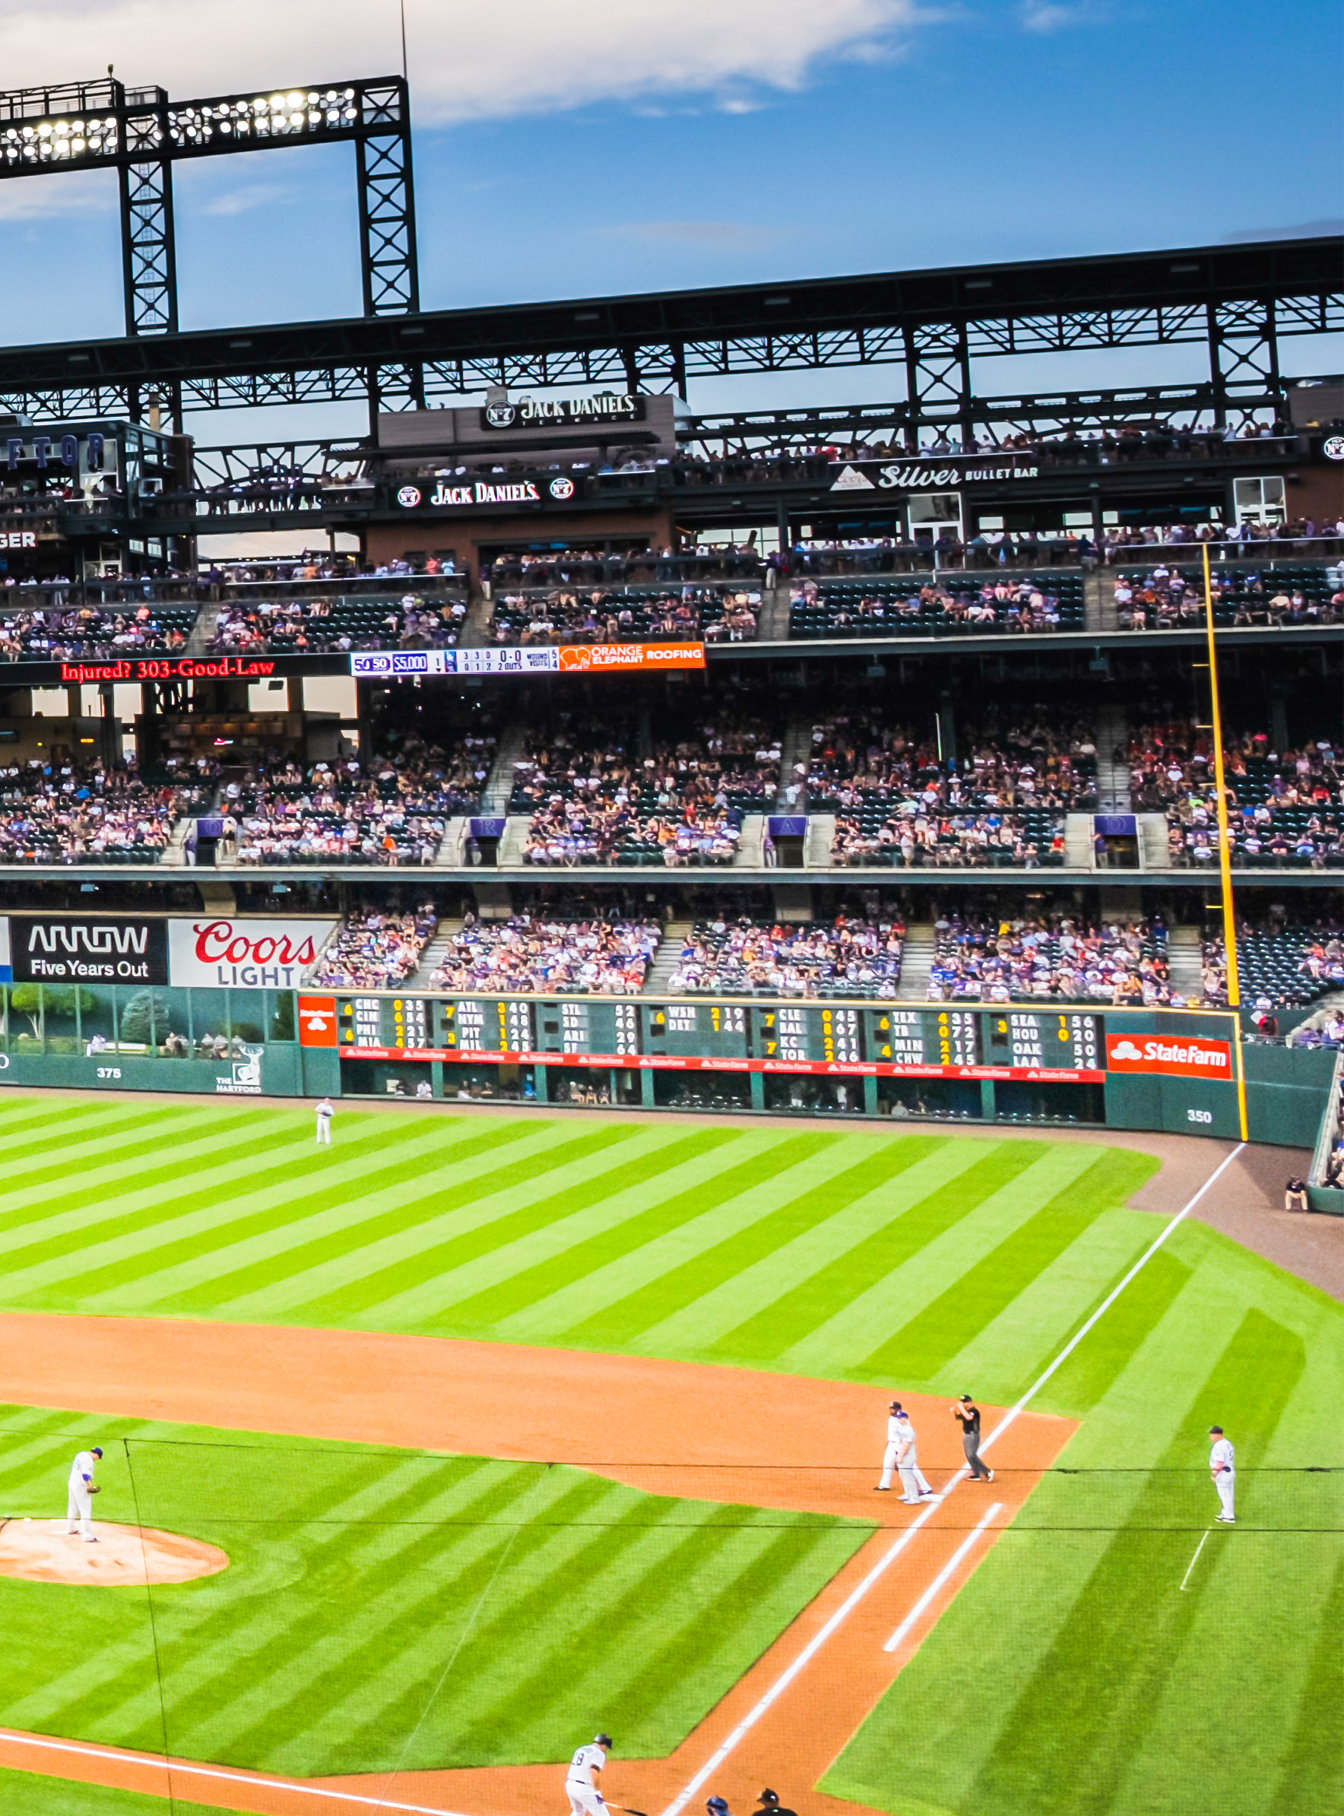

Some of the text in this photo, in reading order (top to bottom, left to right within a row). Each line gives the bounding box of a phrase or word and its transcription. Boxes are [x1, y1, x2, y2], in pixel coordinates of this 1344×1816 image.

[520, 396, 566, 419] JACK
[877, 463, 1039, 490] Silver BULLET BAR
[430, 484, 474, 506] JACK
[591, 646, 643, 657] ORANGE
[646, 649, 702, 660] ROOFING
[354, 658, 371, 671] 50
[592, 655, 644, 664] ELEPHANT
[61, 659, 275, 682] Injured? 303-Good-Law
[192, 920, 316, 966] Coors
[31, 959, 149, 978] Five Years Out
[218, 966, 295, 987] LIGHT
[355, 999, 380, 1011] CHC
[458, 1001, 478, 1013] ATL
[778, 1009, 801, 1021] CLE
[1011, 1014, 1037, 1027] SEA
[461, 1026, 481, 1039] PIT
[893, 1025, 909, 1037] TB
[1012, 1028, 1039, 1041] HOU
[780, 1036, 798, 1048] KC
[1143, 1042, 1227, 1067] StateFarm
[96, 1067, 122, 1079] 375
[216, 1076, 233, 1085] THE
[216, 1084, 262, 1093] HARTFORD
[1187, 1109, 1213, 1124] 350
